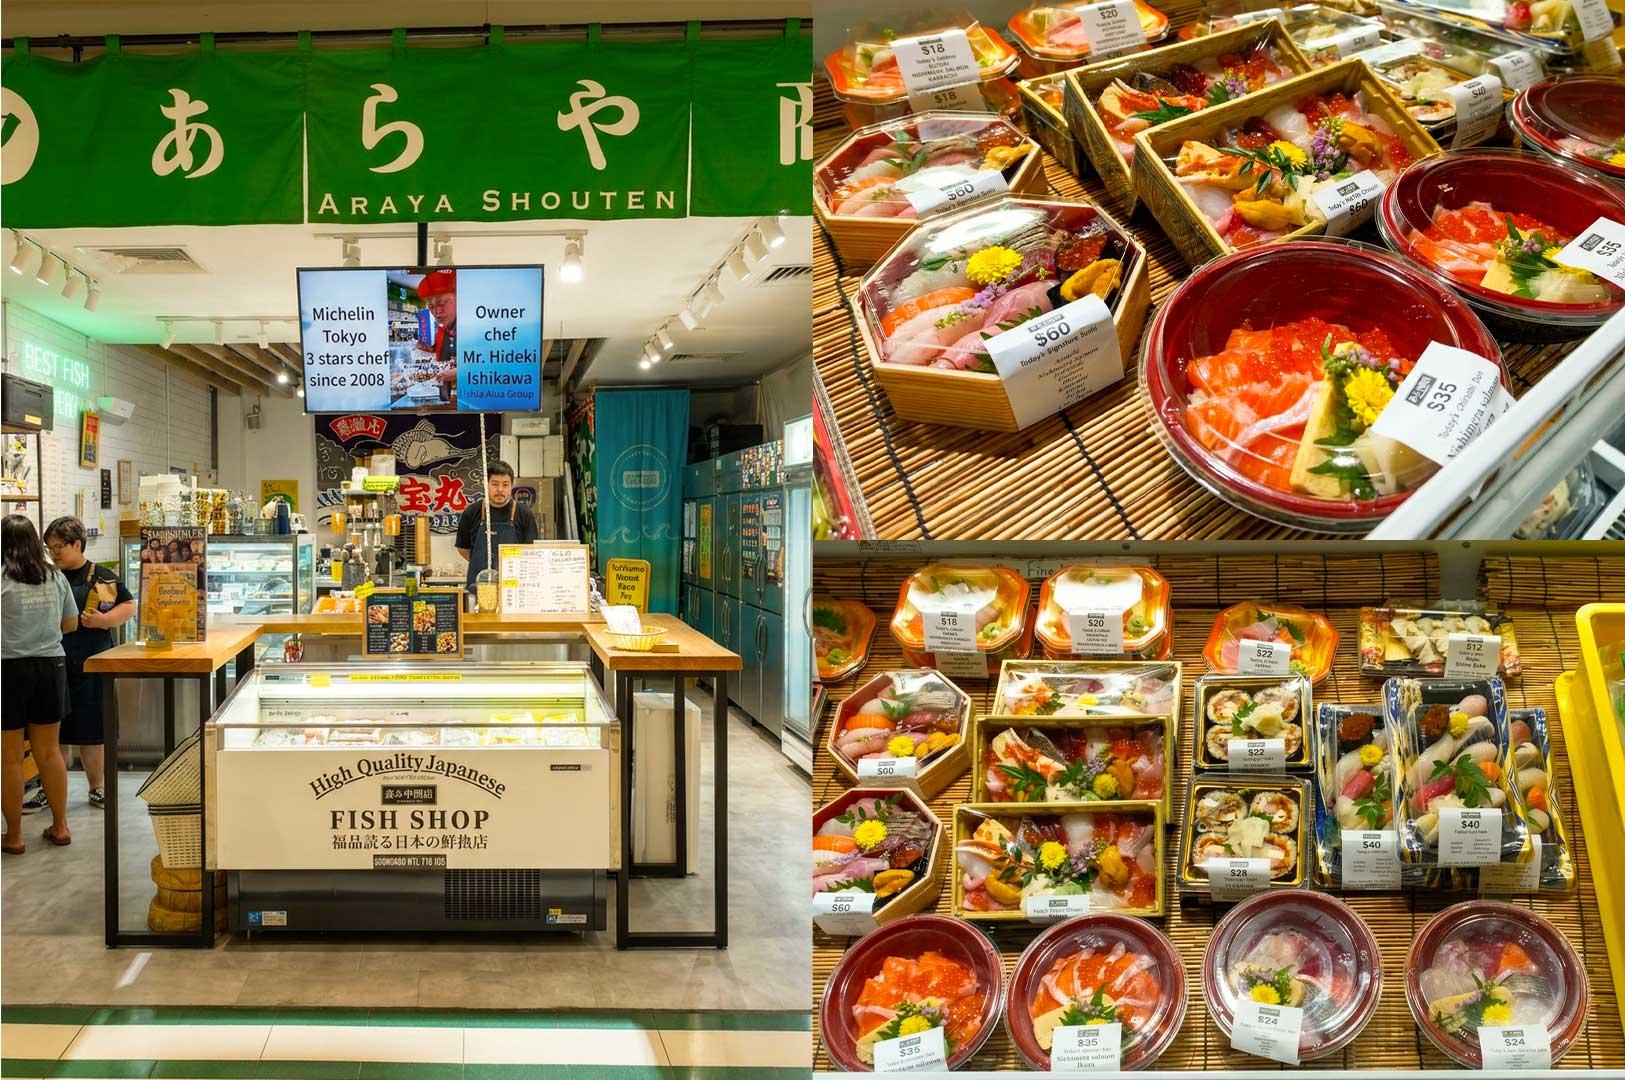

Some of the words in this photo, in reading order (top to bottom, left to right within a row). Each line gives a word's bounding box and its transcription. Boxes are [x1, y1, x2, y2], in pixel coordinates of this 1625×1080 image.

[318, 193, 454, 215] ARAYA
[481, 189, 675, 212] SHOUTEN
[312, 306, 375, 321] Michelin
[475, 305, 526, 319] Owner
[322, 329, 367, 347] Tokyo
[484, 326, 517, 341] chef
[1034, 321, 1071, 348] $60
[306, 352, 315, 366] 3
[318, 352, 354, 366] stars
[357, 350, 389, 365] chef
[463, 350, 485, 364] Mr.
[489, 348, 537, 364] Hideki
[25, 343, 59, 378] BEST
[63, 357, 90, 390] FISH
[310, 373, 346, 387] since
[350, 373, 385, 387] 2008
[467, 370, 532, 385] Ishikawa
[507, 390, 534, 399] Group
[1427, 382, 1457, 412] $35
[309, 765, 353, 797] High
[357, 752, 424, 777] Quality
[425, 754, 506, 796] Japanese
[330, 810, 399, 831] FISH
[410, 810, 490, 831] SHOP
